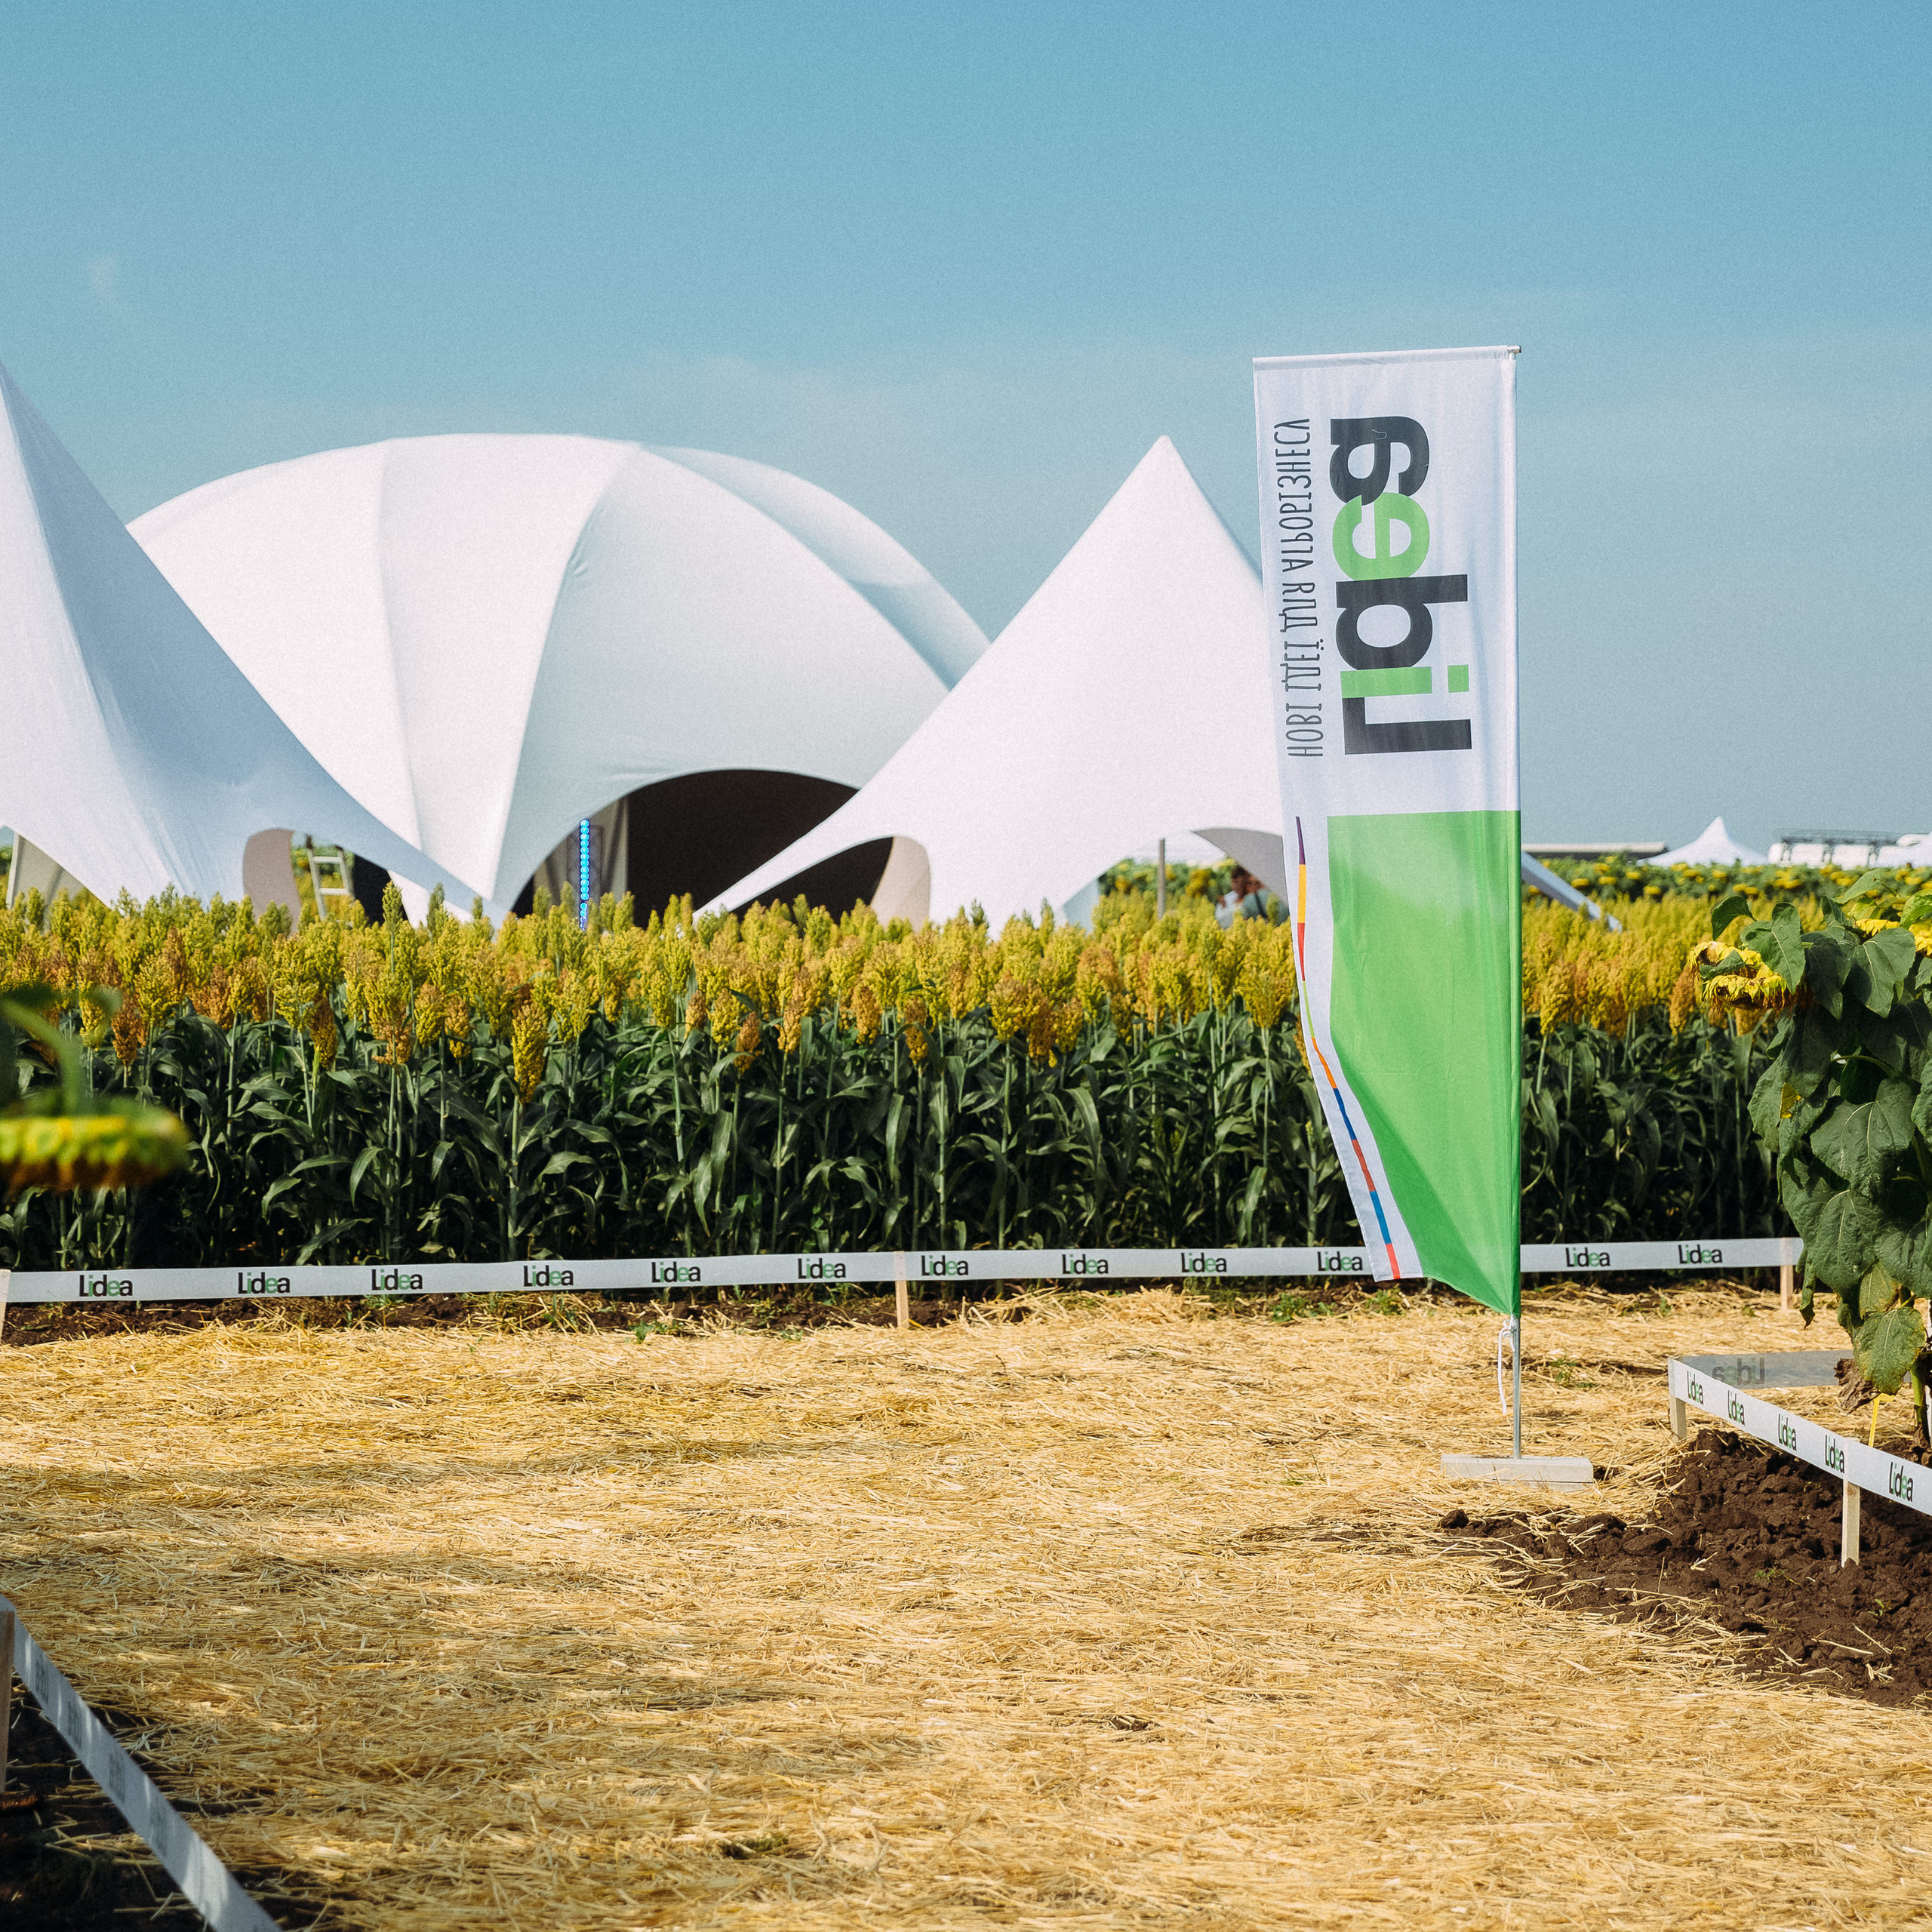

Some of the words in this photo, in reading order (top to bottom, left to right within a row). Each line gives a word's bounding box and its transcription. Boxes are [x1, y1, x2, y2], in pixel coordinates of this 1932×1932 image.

[921, 1254, 969, 1277] Lidea
[1061, 1254, 1109, 1275] Lidea
[1180, 1252, 1229, 1274] Lidea
[1317, 1251, 1364, 1272] Lidea
[1564, 1247, 1611, 1268] Lidea
[1678, 1244, 1723, 1265] Lidea
[371, 1268, 424, 1291] Lidea
[522, 1265, 574, 1287] Lidea
[651, 1261, 702, 1283] Lidea
[797, 1258, 847, 1280] Lidea
[78, 1274, 134, 1297] Lidea
[237, 1271, 291, 1295] Lidea
[1687, 1371, 1703, 1405] Lidea
[1727, 1390, 1745, 1426] Lidea
[1778, 1414, 1797, 1451] Lidea
[1825, 1435, 1844, 1474] Lidea
[1889, 1461, 1913, 1503] Lidea
